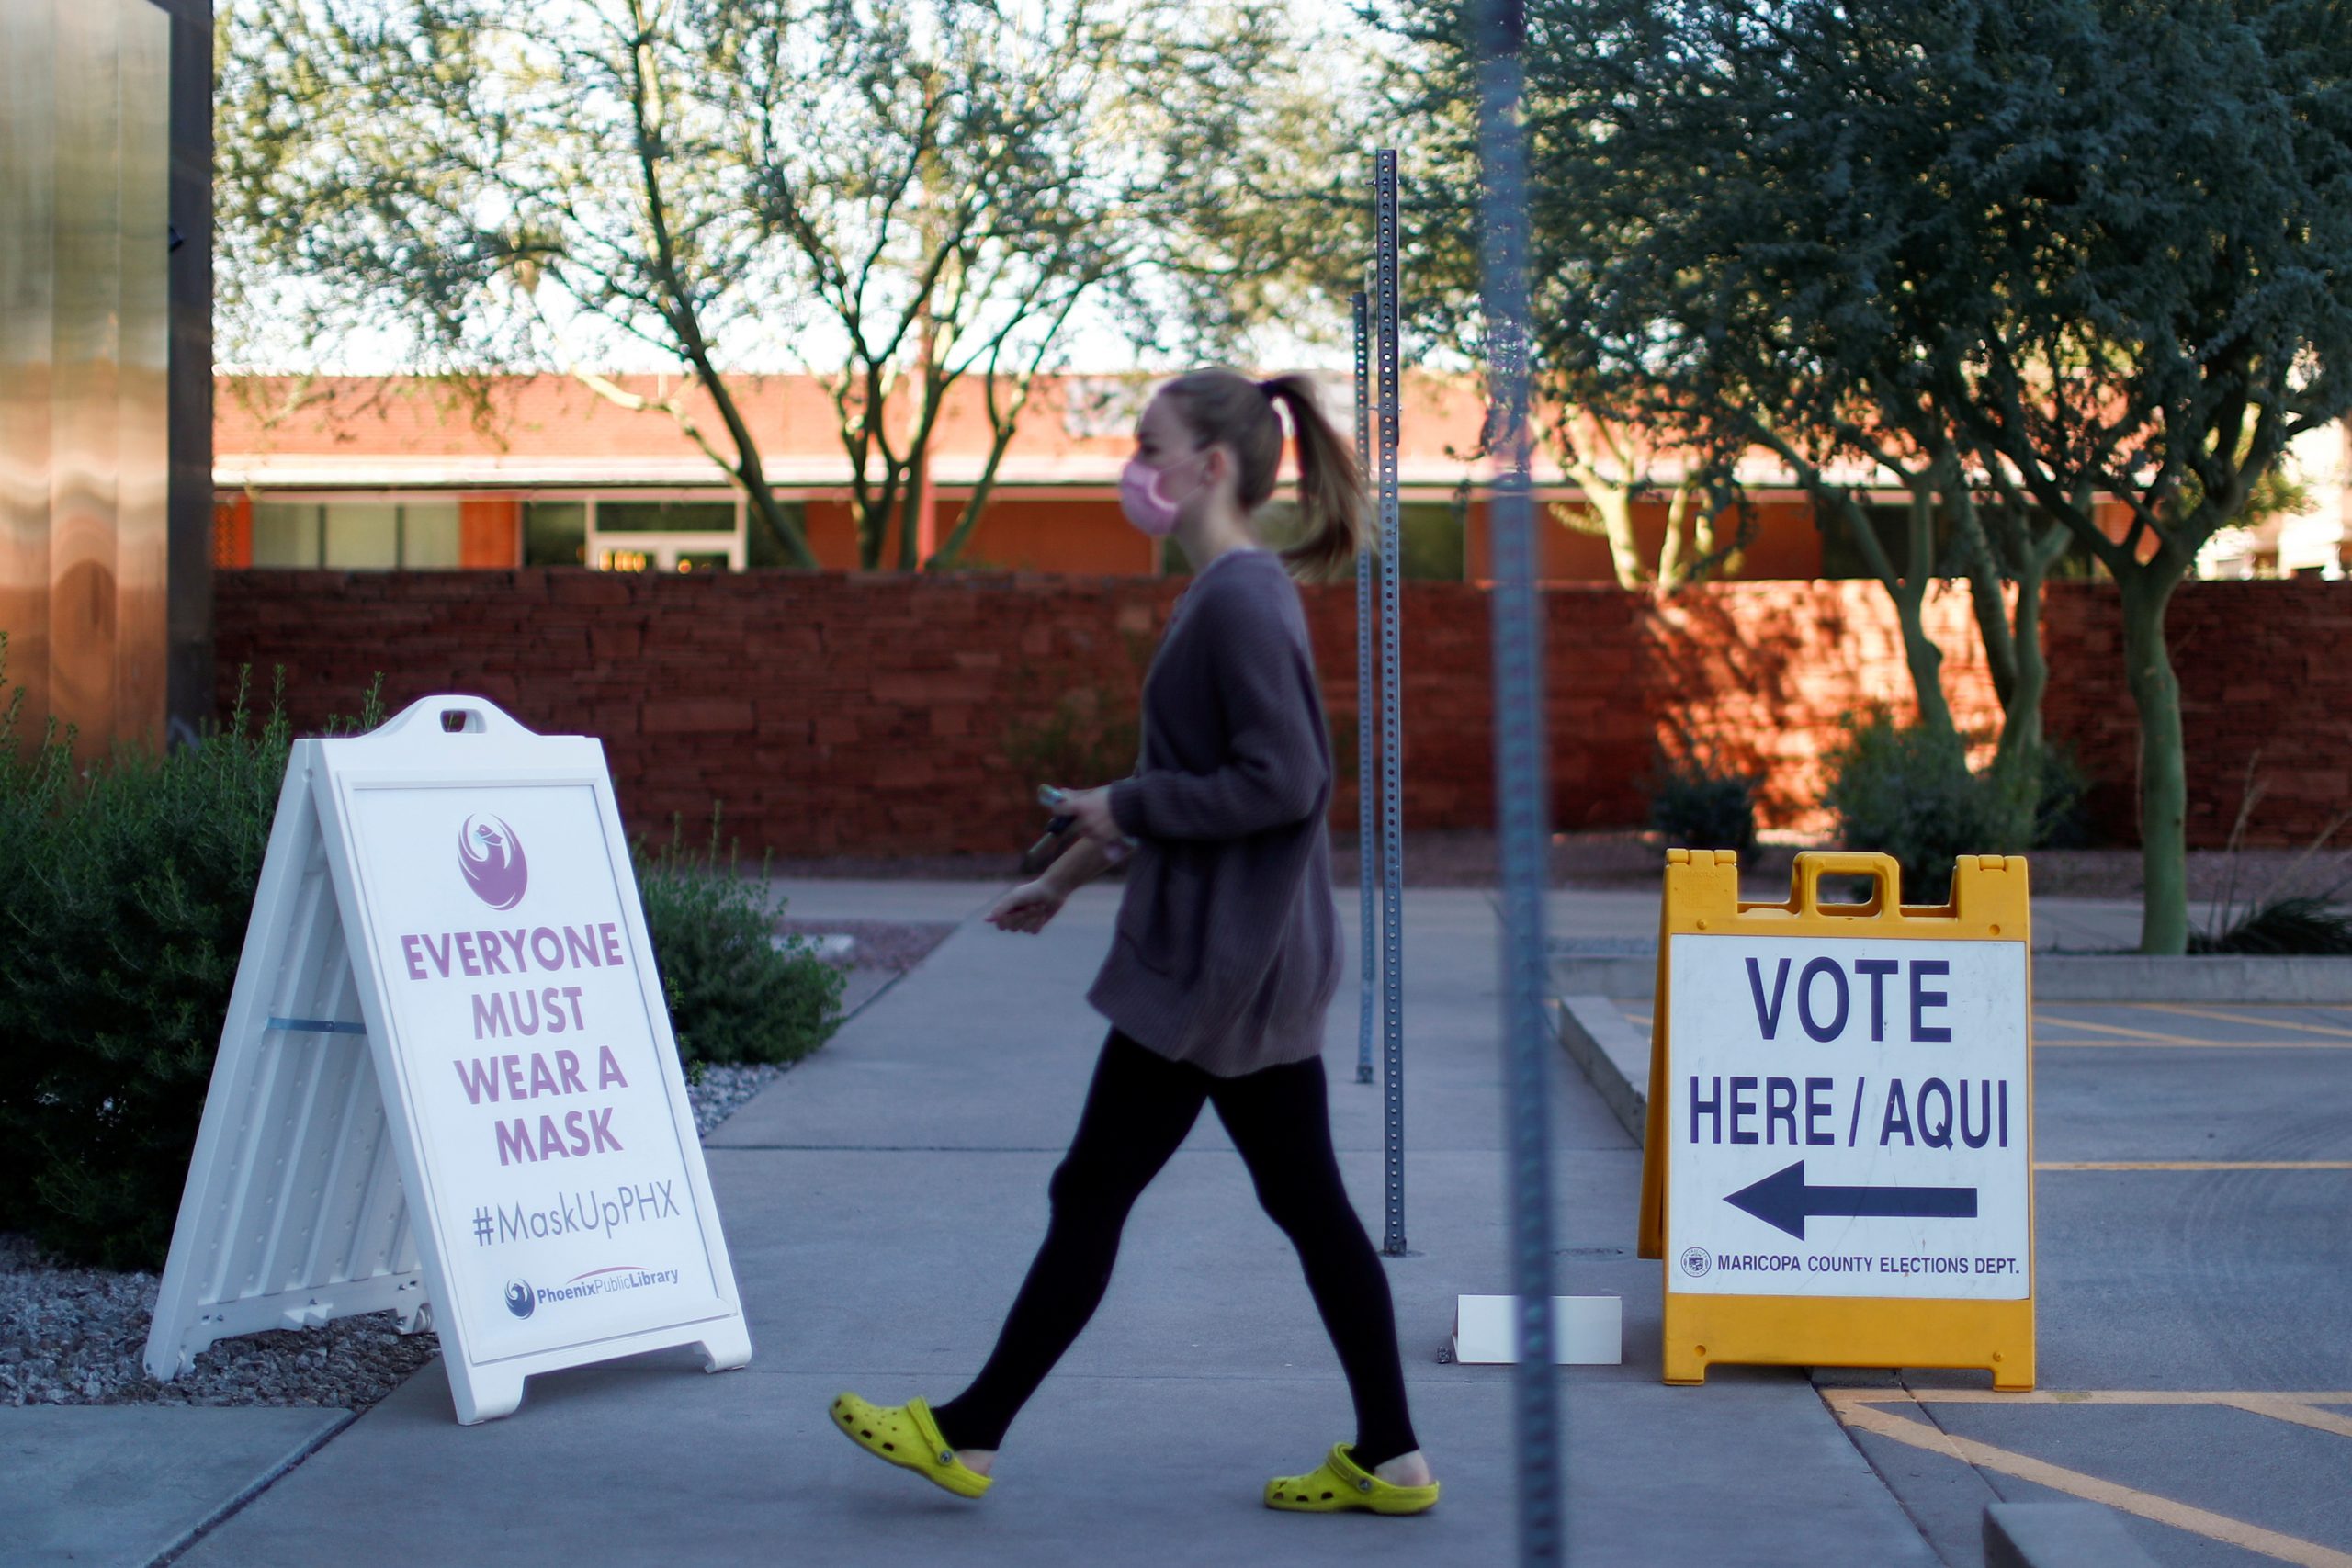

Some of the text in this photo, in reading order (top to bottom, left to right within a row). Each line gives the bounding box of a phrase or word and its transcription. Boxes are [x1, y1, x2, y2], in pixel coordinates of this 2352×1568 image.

[401, 922, 624, 980] EVERYONE
[472, 987, 584, 1039] MUST
[1745, 957, 1951, 1043] VOTE
[454, 1045, 628, 1104] WEAR A
[495, 1107, 623, 1166] MASK
[473, 1180, 680, 1247] #MaskUpPHX
[1718, 1255, 1801, 1271] MARICOPA
[1808, 1256, 1872, 1272] COUNTY
[1881, 1257, 1968, 1273] ELECTIONS
[1975, 1258, 2019, 1273] DEPT.
